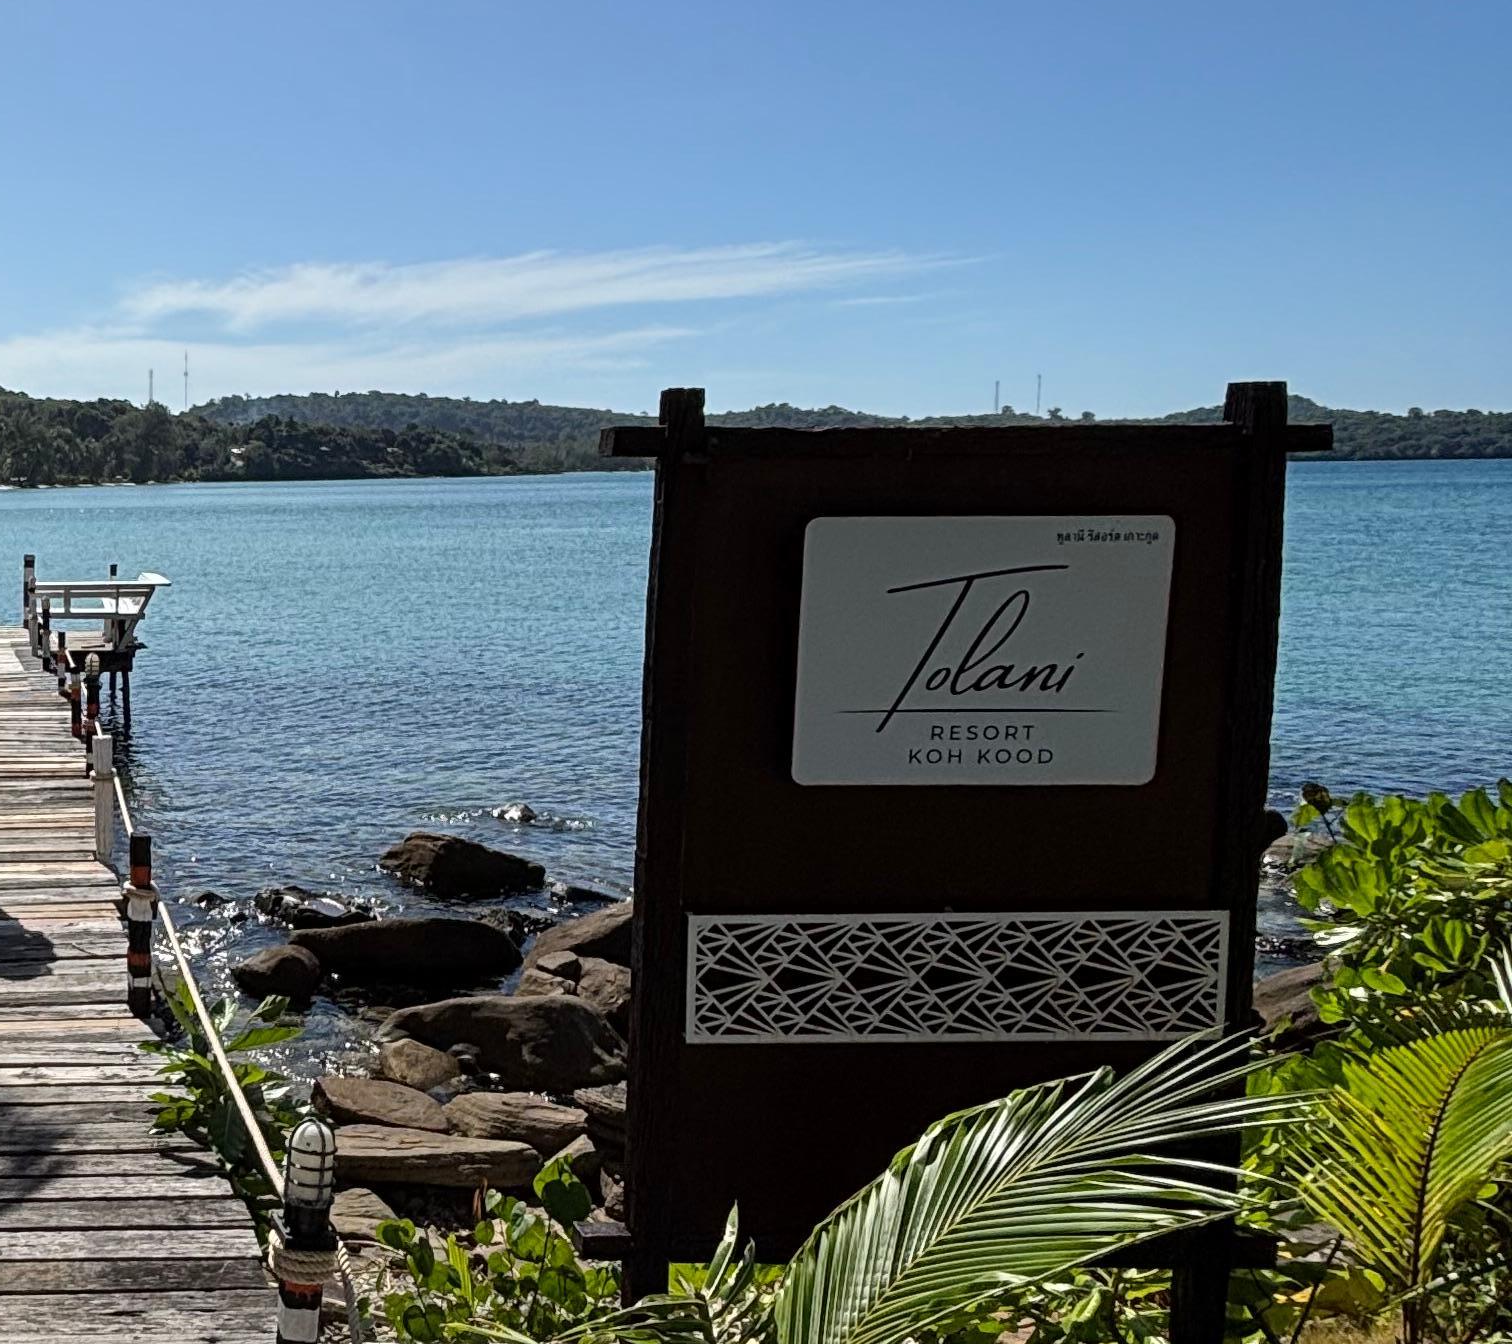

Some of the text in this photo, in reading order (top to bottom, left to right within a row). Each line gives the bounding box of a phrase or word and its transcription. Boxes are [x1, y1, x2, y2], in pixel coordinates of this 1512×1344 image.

[876, 565, 1085, 733] Tolani
[930, 725, 1036, 740] RESORT
[908, 748, 1055, 764] KOH KOOD
